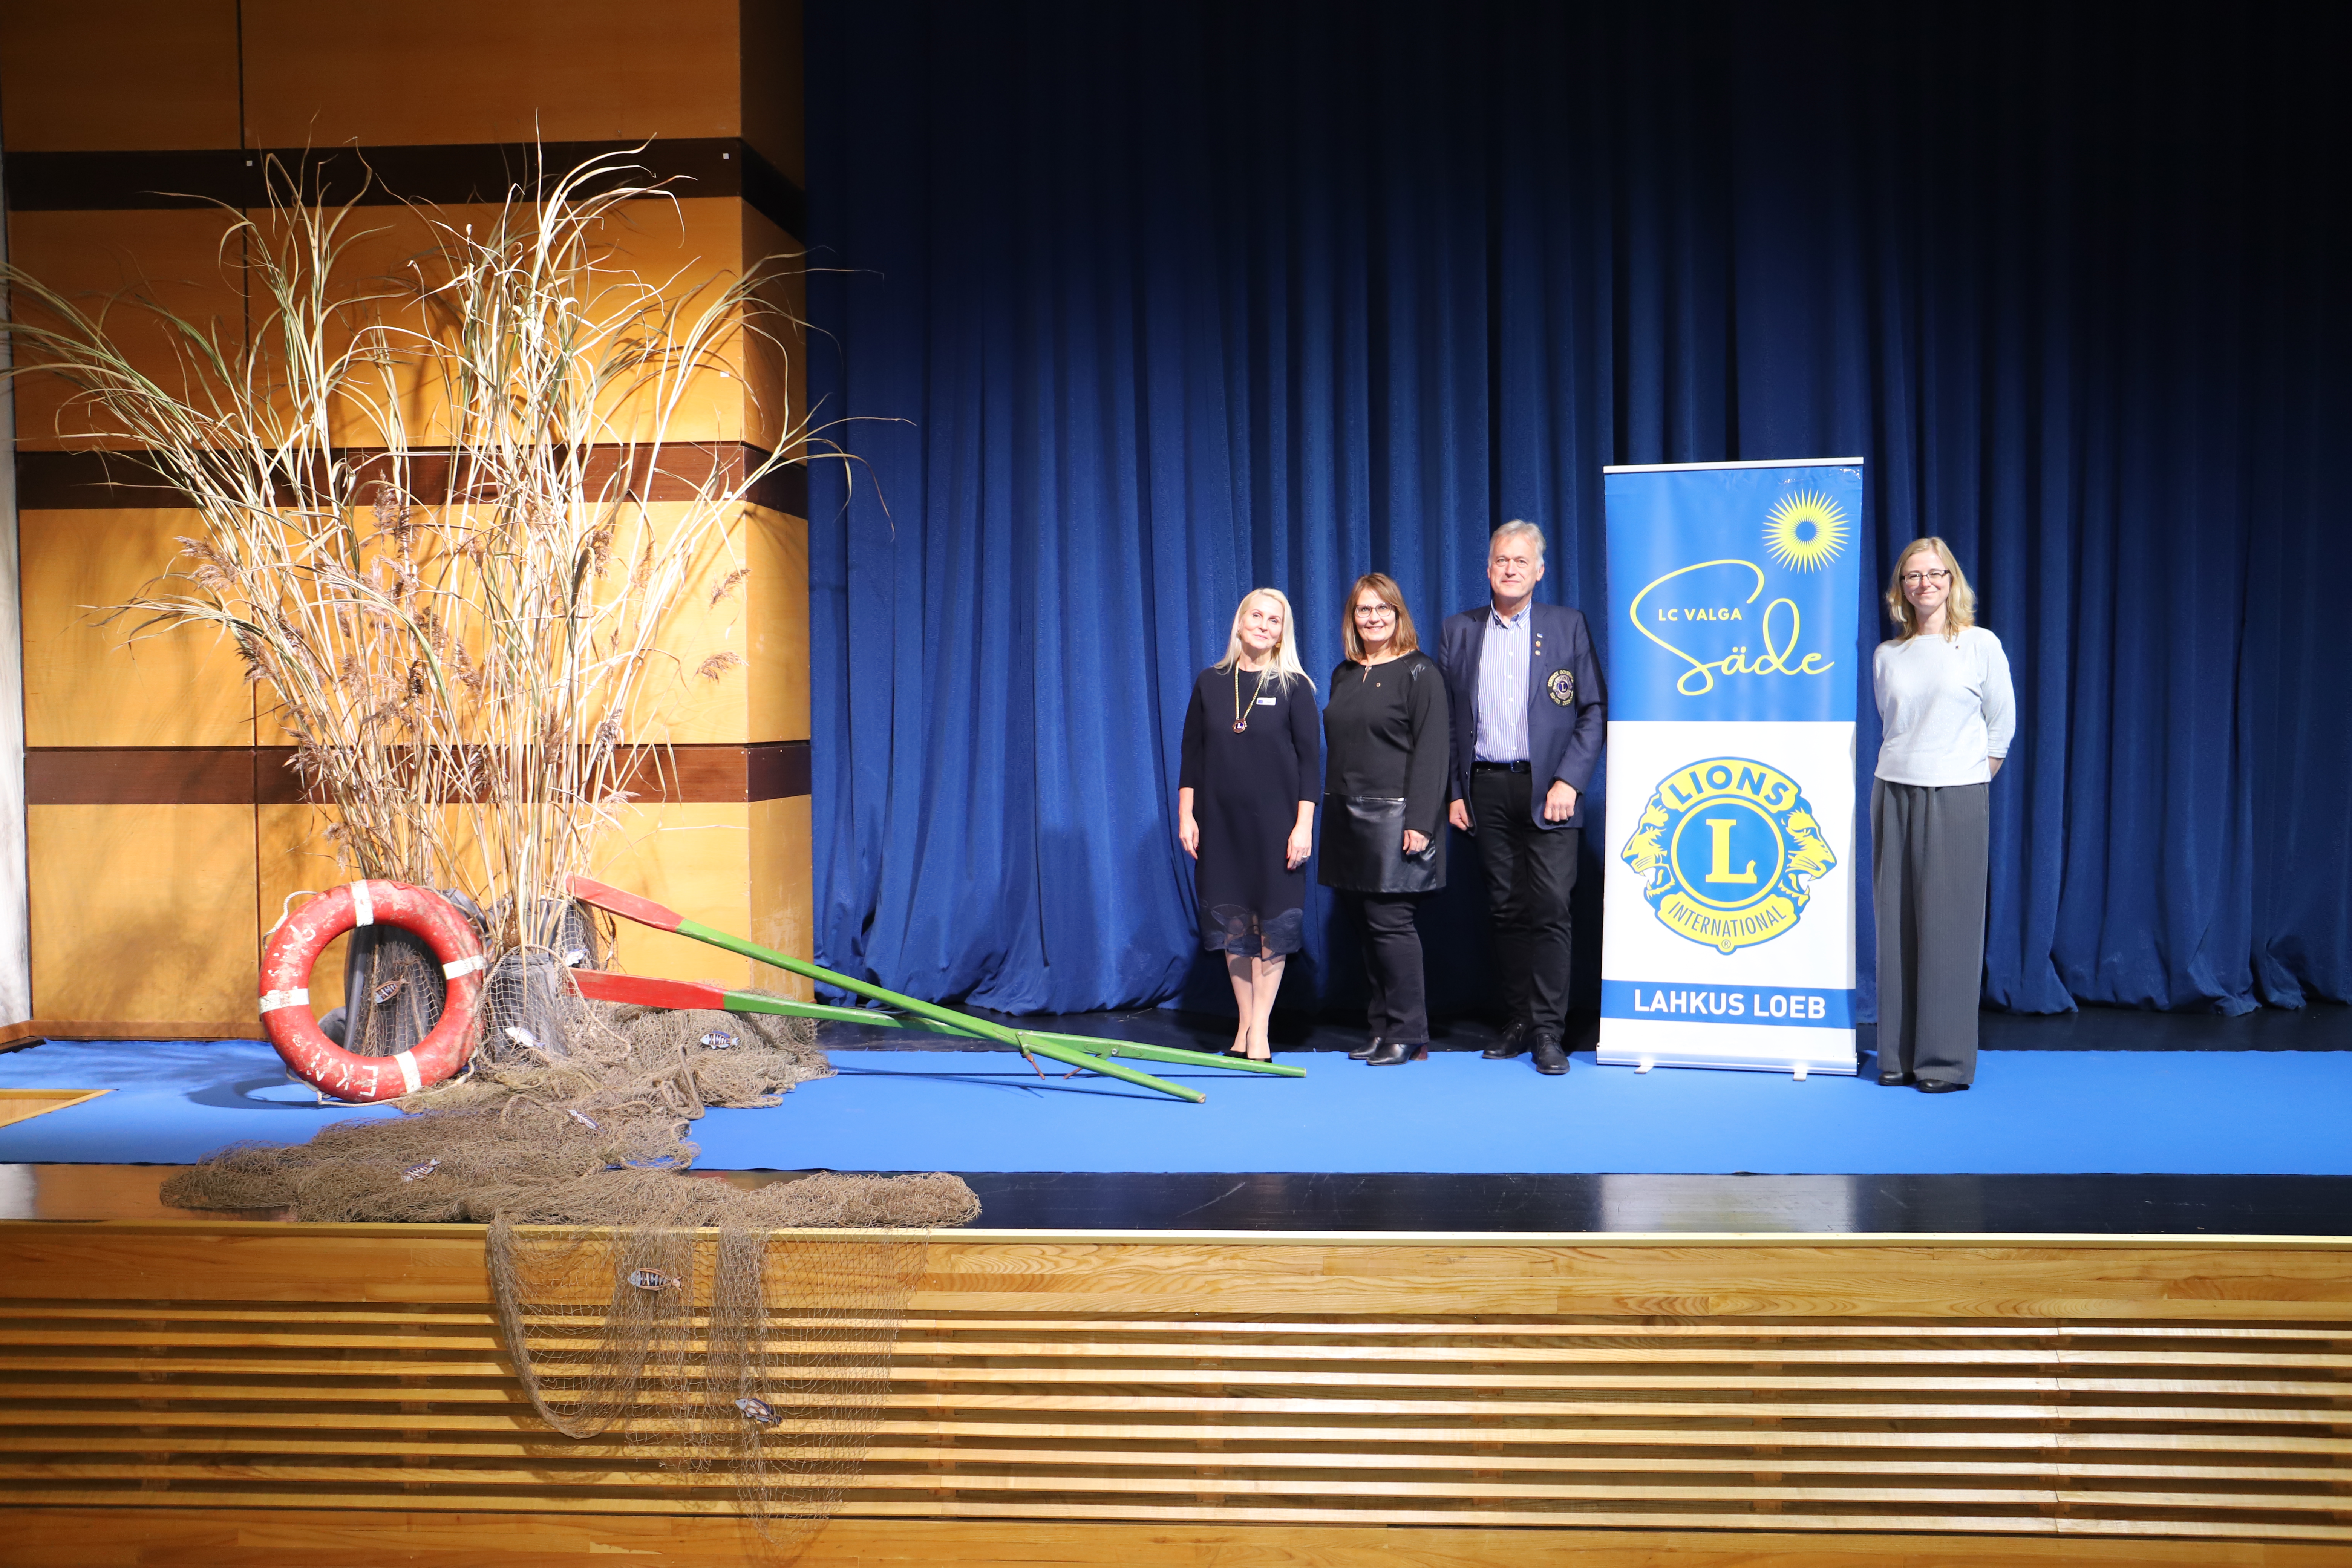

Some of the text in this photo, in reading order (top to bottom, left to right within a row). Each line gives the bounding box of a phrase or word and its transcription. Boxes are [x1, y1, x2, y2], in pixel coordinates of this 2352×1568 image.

[1630, 559, 1835, 696] Säde
[1658, 608, 1742, 621] LC VALGA
[1560, 683, 1567, 691] L
[1668, 765, 1790, 806] LIONS
[1706, 819, 1757, 883] L
[1669, 902, 1787, 937] INTERNATIONAL
[1634, 989, 1826, 1019] LAHKUS LOEB
